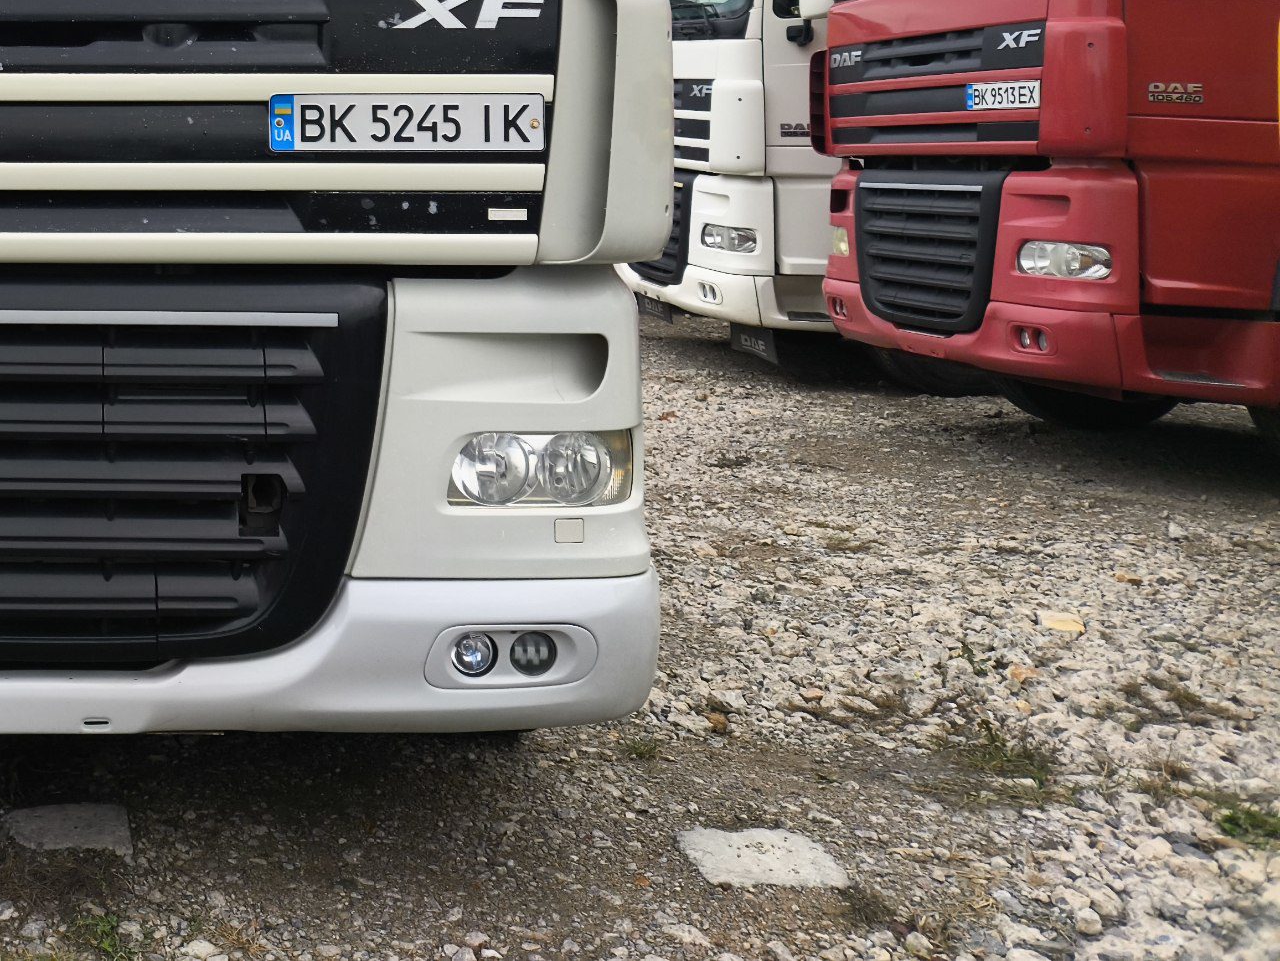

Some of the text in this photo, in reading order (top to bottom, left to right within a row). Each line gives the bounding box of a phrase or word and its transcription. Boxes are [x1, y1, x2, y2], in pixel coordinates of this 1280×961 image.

[996, 29, 1042, 50] XF
[830, 50, 862, 68] DAF
[972, 85, 1036, 106] BK 9513 EX
[1148, 82, 1203, 93] DAF
[300, 104, 531, 143] BK 5245 IK
[275, 130, 292, 142] UA
[644, 299, 664, 313] DAF
[740, 333, 767, 351] DAF
